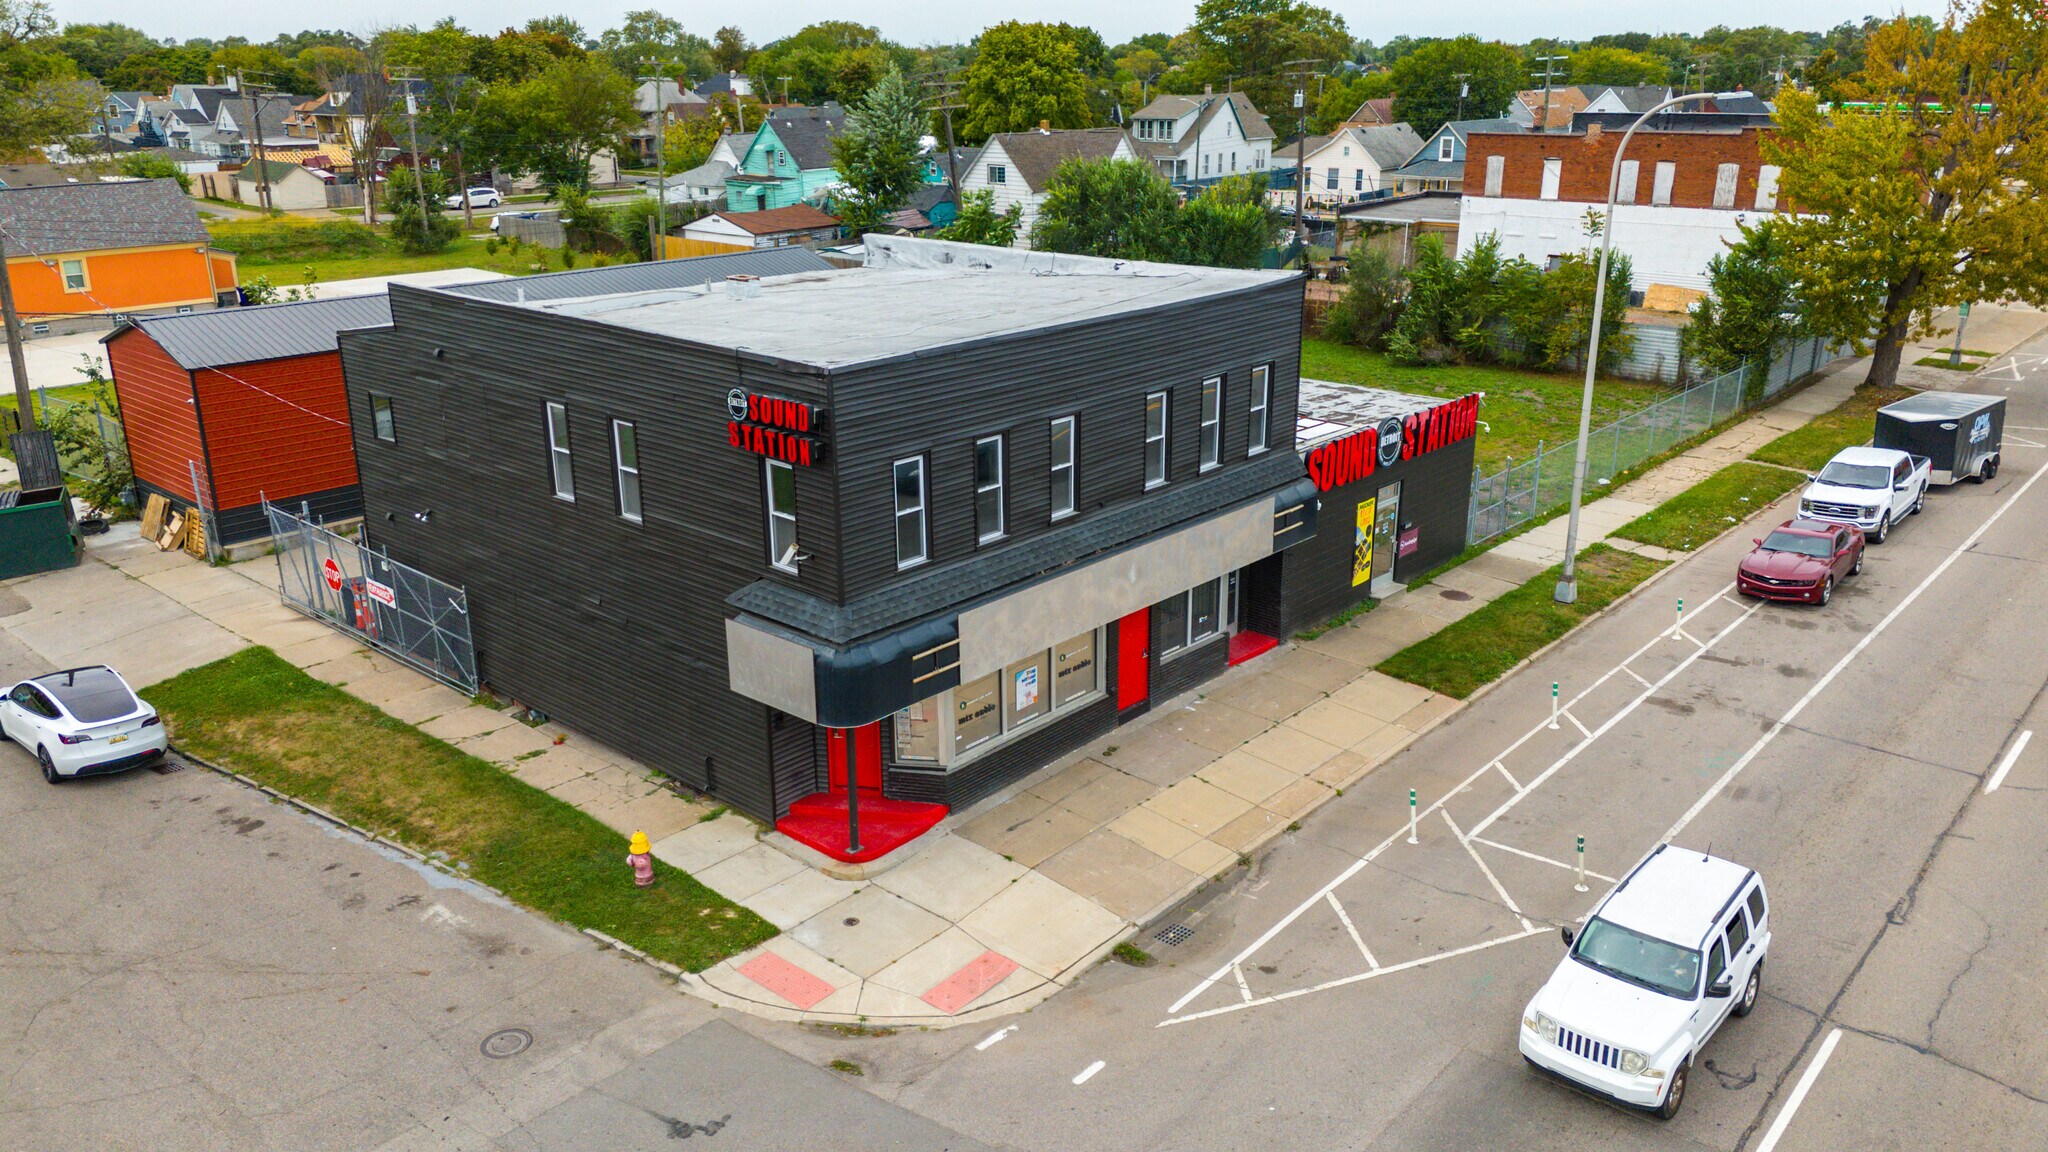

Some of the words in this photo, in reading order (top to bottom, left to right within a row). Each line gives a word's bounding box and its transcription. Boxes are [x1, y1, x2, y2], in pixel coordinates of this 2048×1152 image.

[749, 394, 808, 432] SOUND
[727, 421, 810, 467] STATION
[1309, 427, 1377, 492] SOUND
[1381, 432, 1402, 448] DETROIT
[1402, 393, 1479, 461] STATION
[325, 567, 340, 583] STOP
